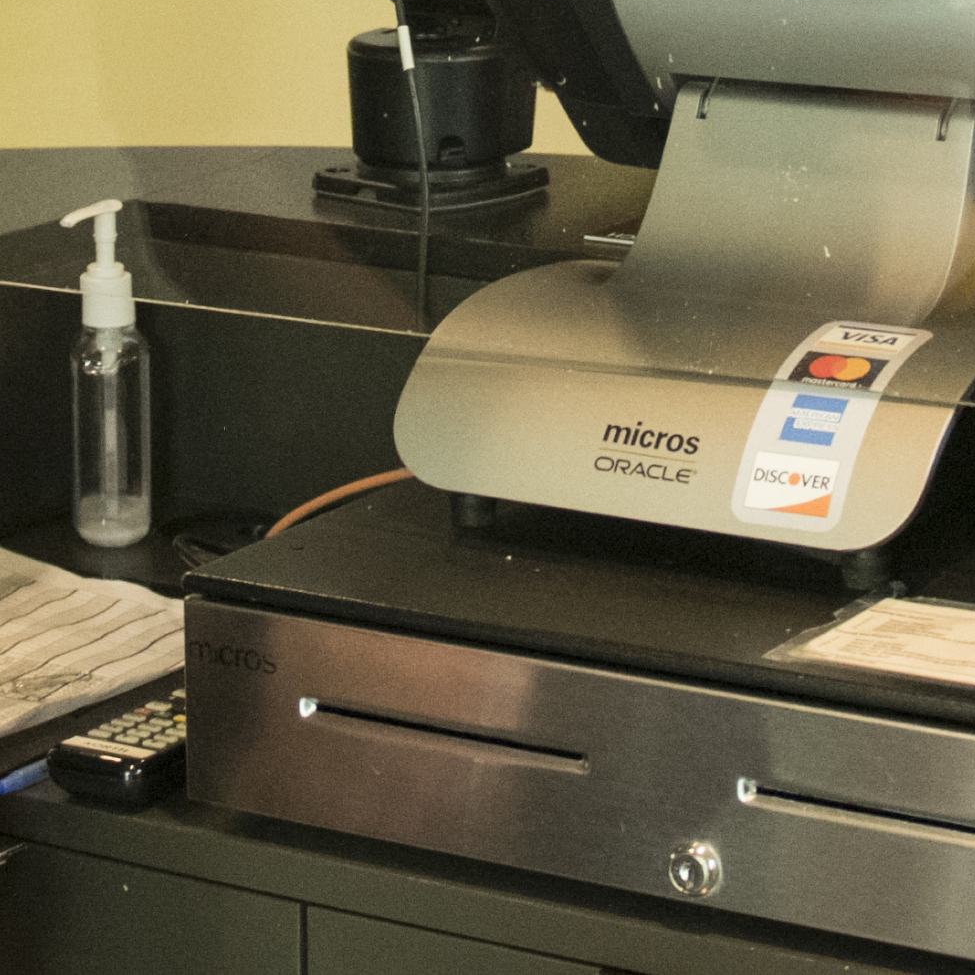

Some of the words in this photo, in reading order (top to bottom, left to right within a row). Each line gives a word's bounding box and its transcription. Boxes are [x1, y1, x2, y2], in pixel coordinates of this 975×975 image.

[841, 331, 899, 346] VISA
[801, 376, 858, 389] mastercard
[602, 421, 700, 455] micros
[593, 455, 692, 484] ORACLE
[753, 467, 830, 491] DISCOVER
[188, 640, 277, 674] micros
